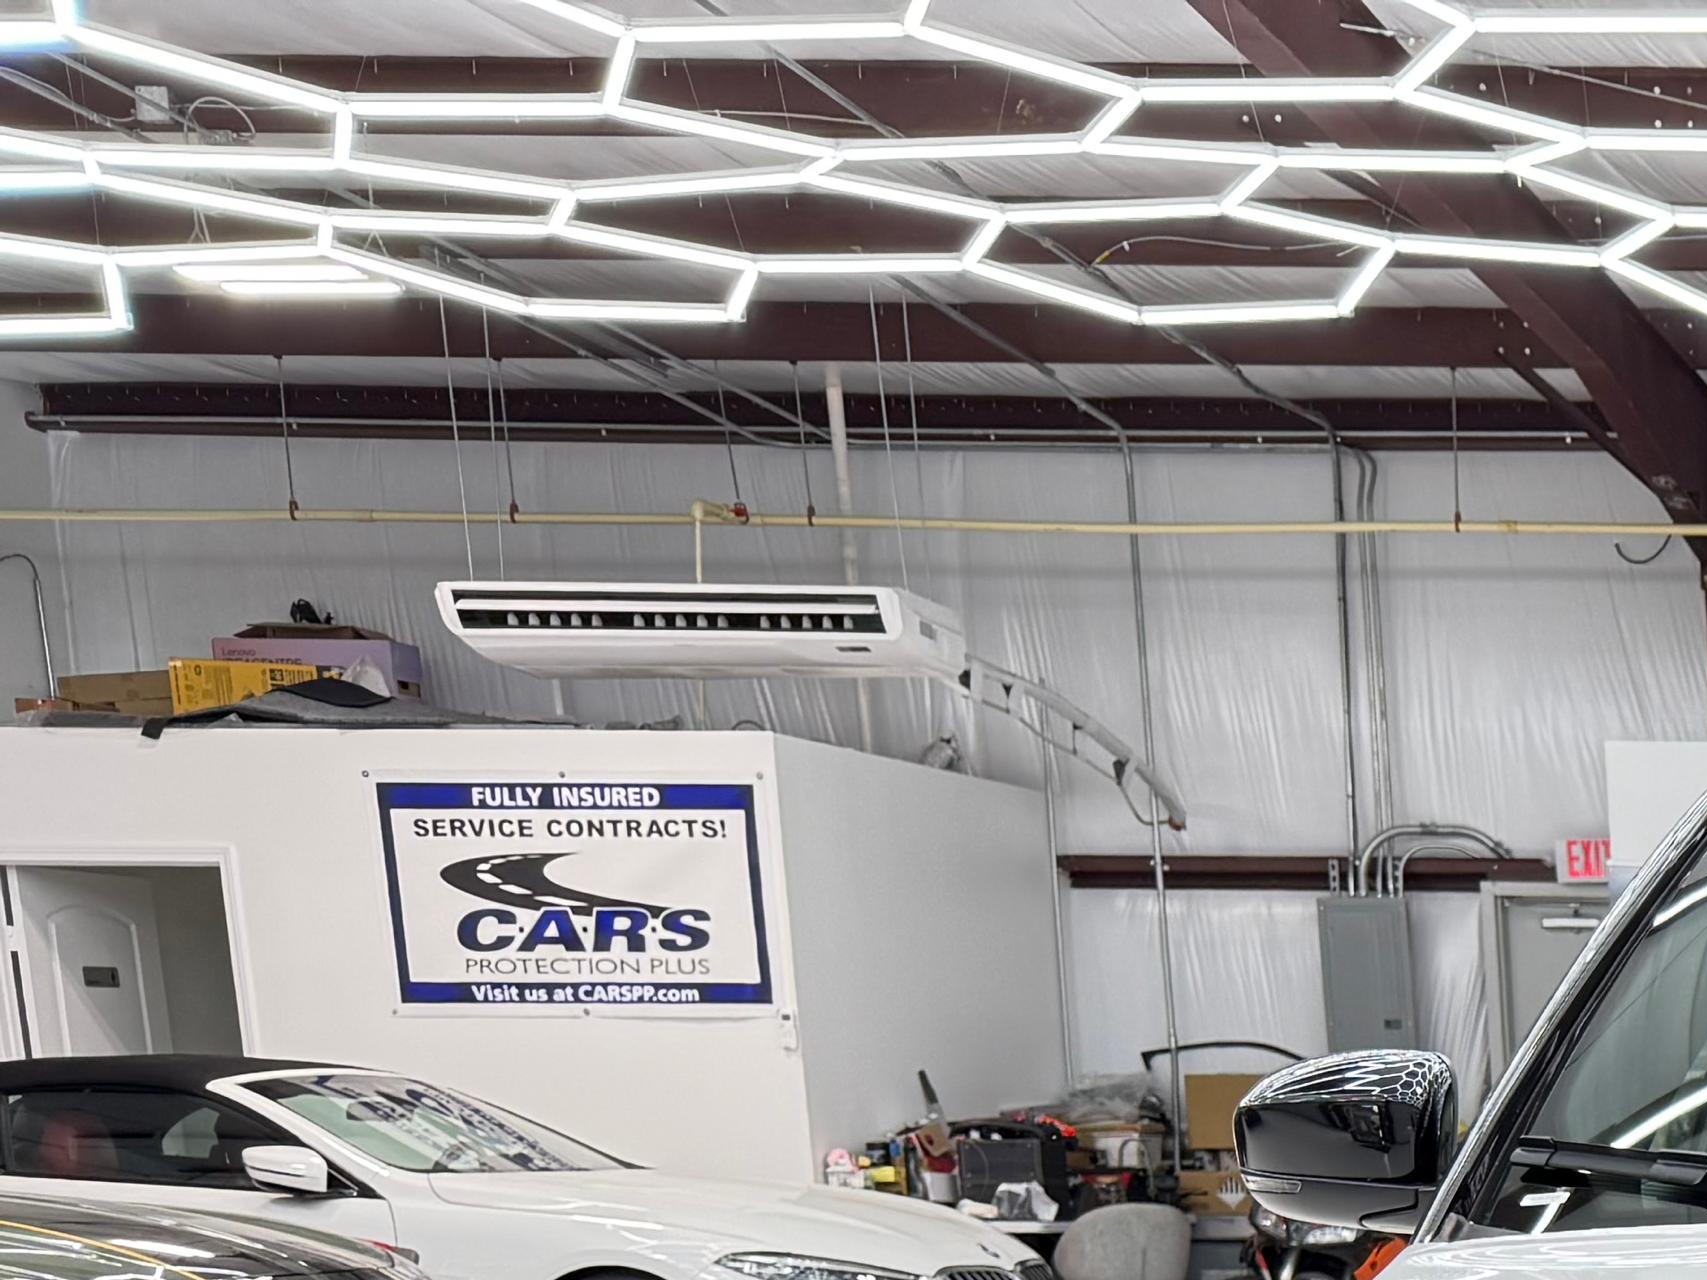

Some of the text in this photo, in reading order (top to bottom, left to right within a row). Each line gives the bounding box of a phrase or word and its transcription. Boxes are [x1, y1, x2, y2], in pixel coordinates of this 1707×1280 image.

[221, 647, 257, 656] Lenovo
[471, 786, 661, 807] FULLY INSURED
[413, 818, 727, 838] SERVICE CONTRACTS!
[465, 958, 710, 975] PROTECTION PLUS
[471, 983, 700, 1002] Visit us at CARSPP.com
